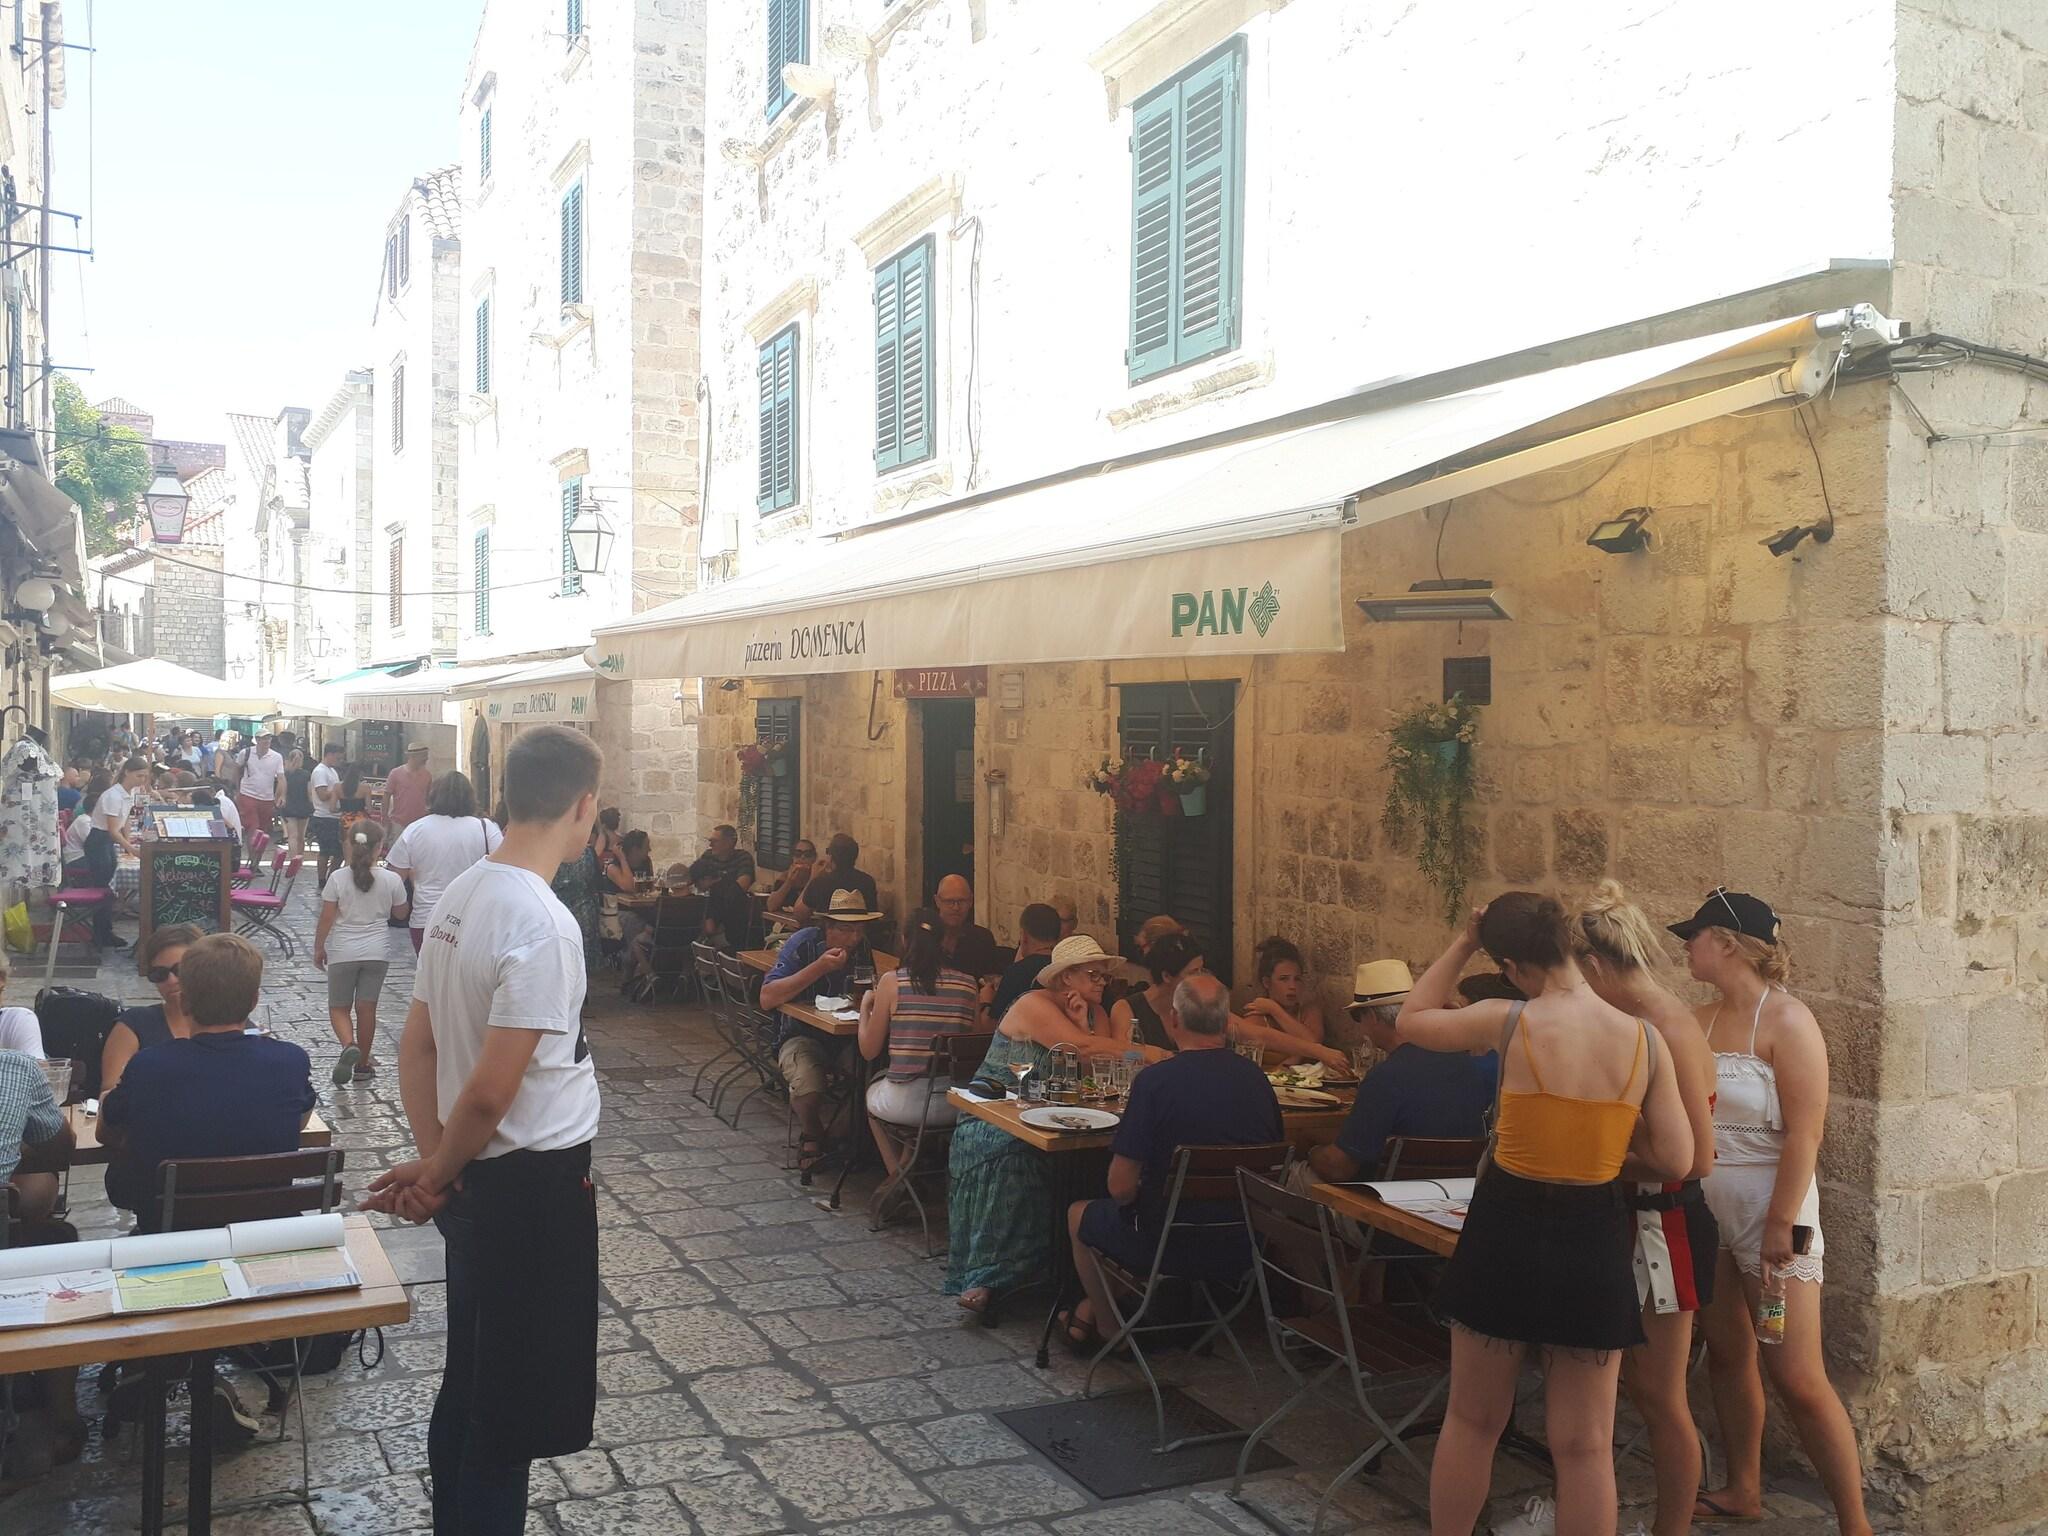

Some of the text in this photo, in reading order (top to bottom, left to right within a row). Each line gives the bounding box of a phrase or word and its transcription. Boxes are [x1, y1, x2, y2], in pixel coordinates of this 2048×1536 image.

[1171, 587, 1248, 637] PAN
[744, 619, 866, 670] pizzeria DOMENICA
[919, 671, 957, 691] PIZZA
